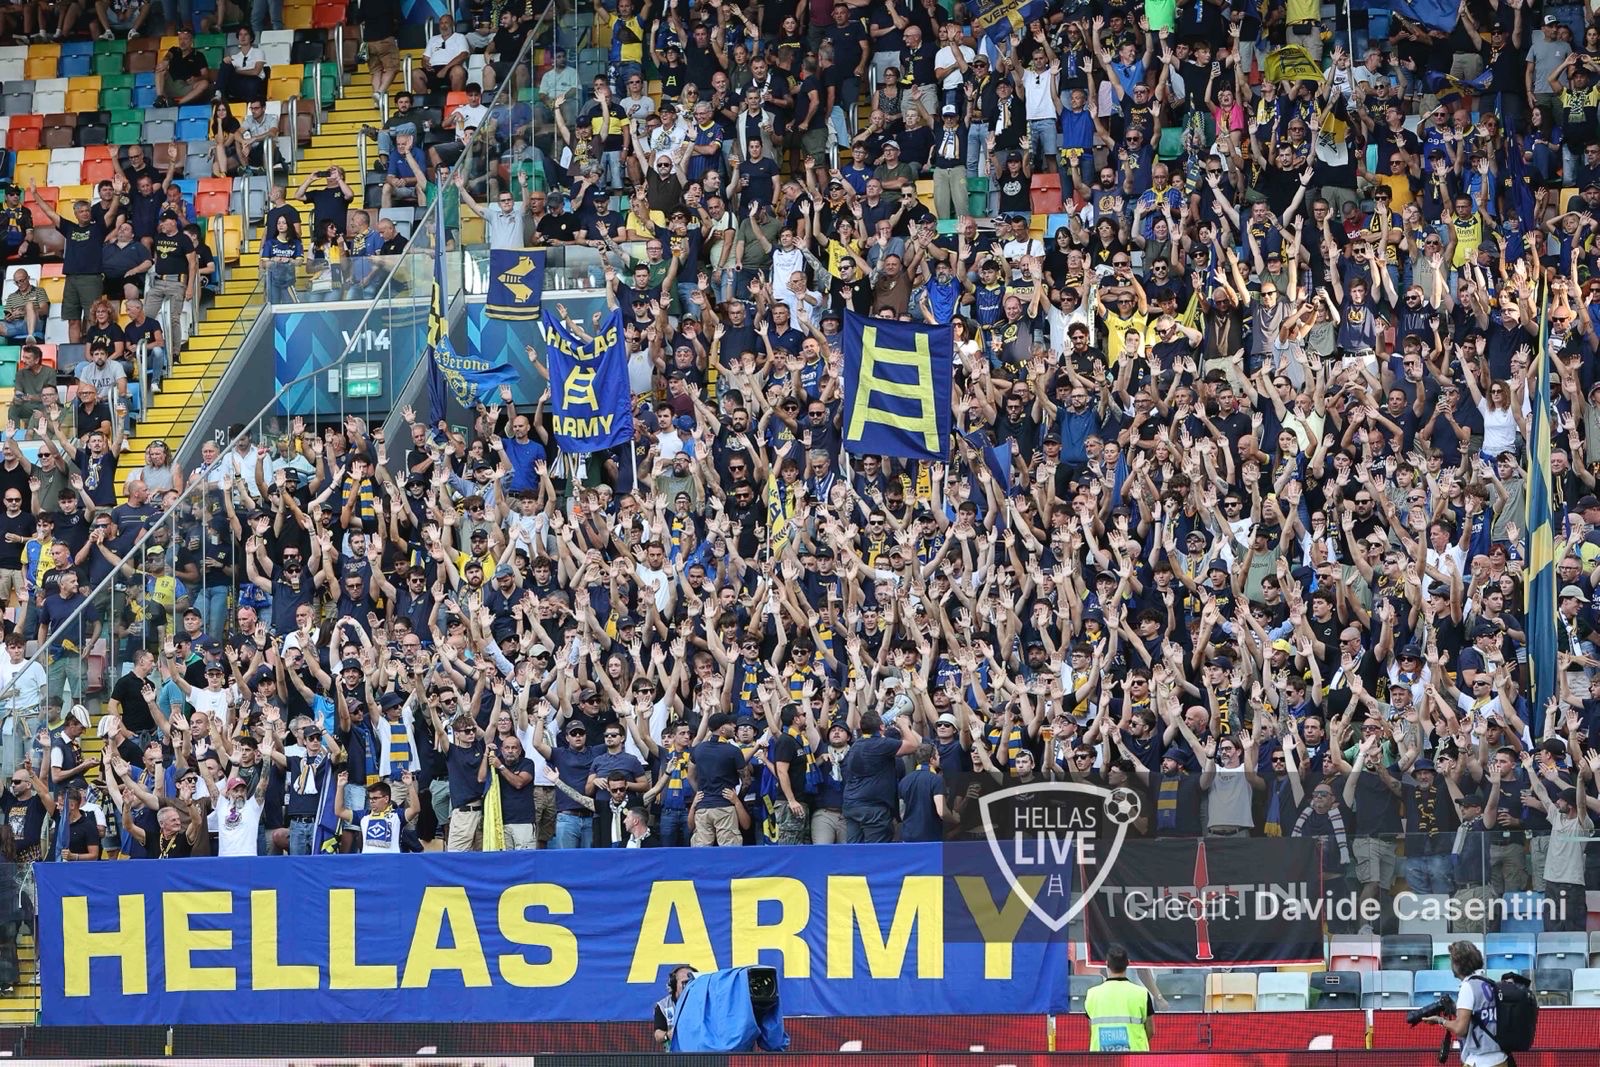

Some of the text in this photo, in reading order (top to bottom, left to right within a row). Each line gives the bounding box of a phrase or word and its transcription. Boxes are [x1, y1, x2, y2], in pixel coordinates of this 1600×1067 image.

[546, 326, 617, 361] HELLAS
[92, 378, 111, 389] YALE
[215, 429, 225, 446] P2
[552, 414, 614, 438] ARMY
[62, 875, 1047, 997] HELLAS ARMY
